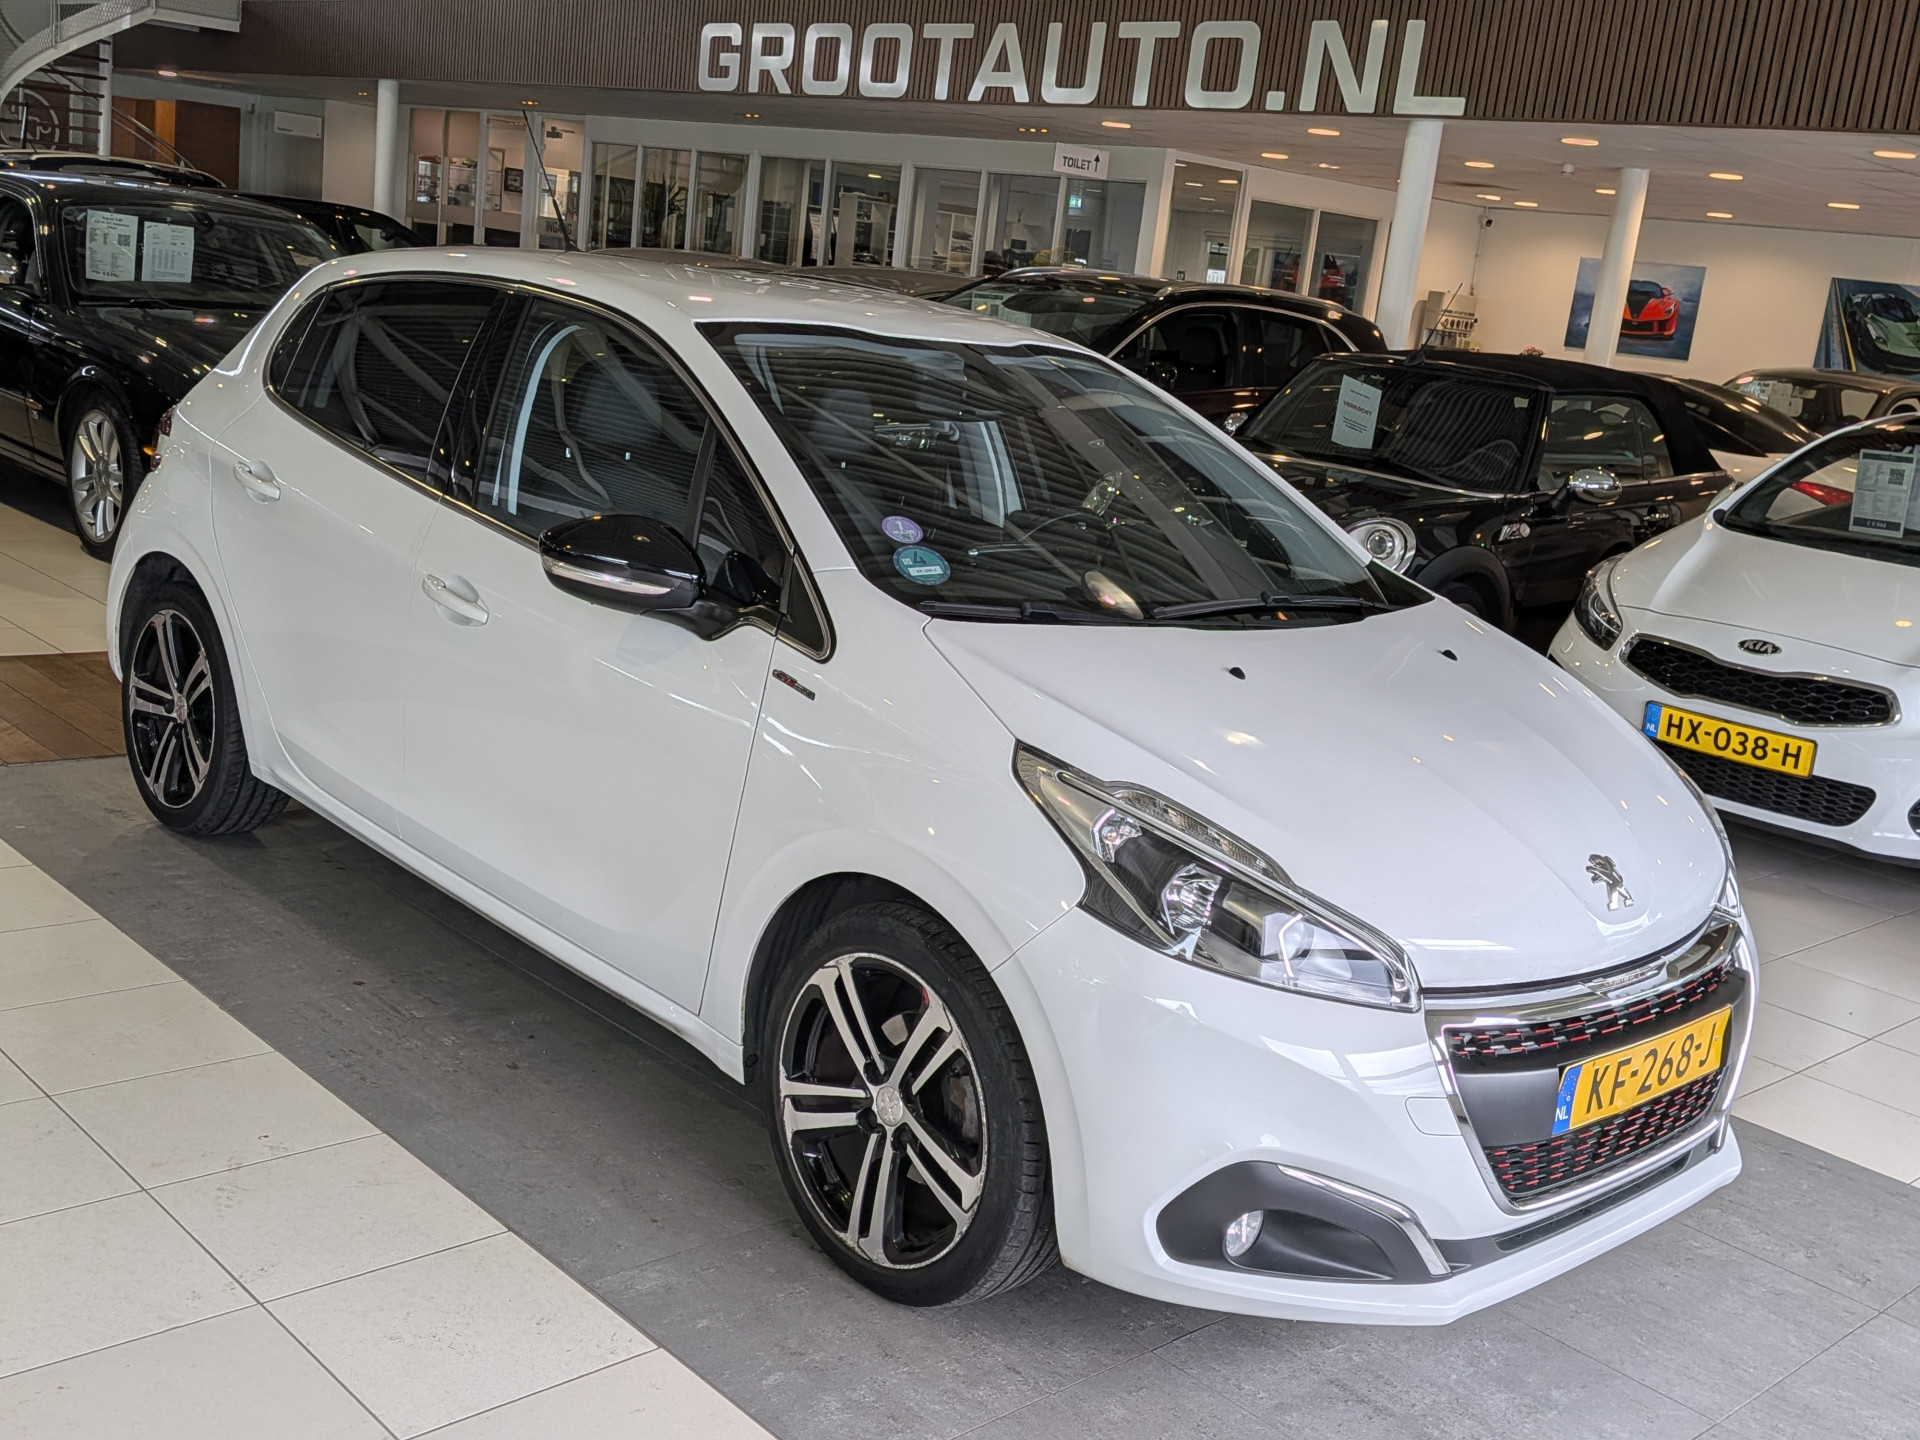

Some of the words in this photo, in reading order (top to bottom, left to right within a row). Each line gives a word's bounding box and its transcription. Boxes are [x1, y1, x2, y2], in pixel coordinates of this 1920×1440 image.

[698, 20, 1466, 116] GROOTAUTO.NL
[1063, 156, 1092, 171] TOILET
[913, 551, 927, 565] 4
[1743, 640, 1772, 654] KIA
[1646, 722, 1657, 733] NL
[1666, 713, 1802, 770] HX-038-H
[1586, 1022, 1717, 1114] KF-268-J
[1554, 1106, 1569, 1122] NL
